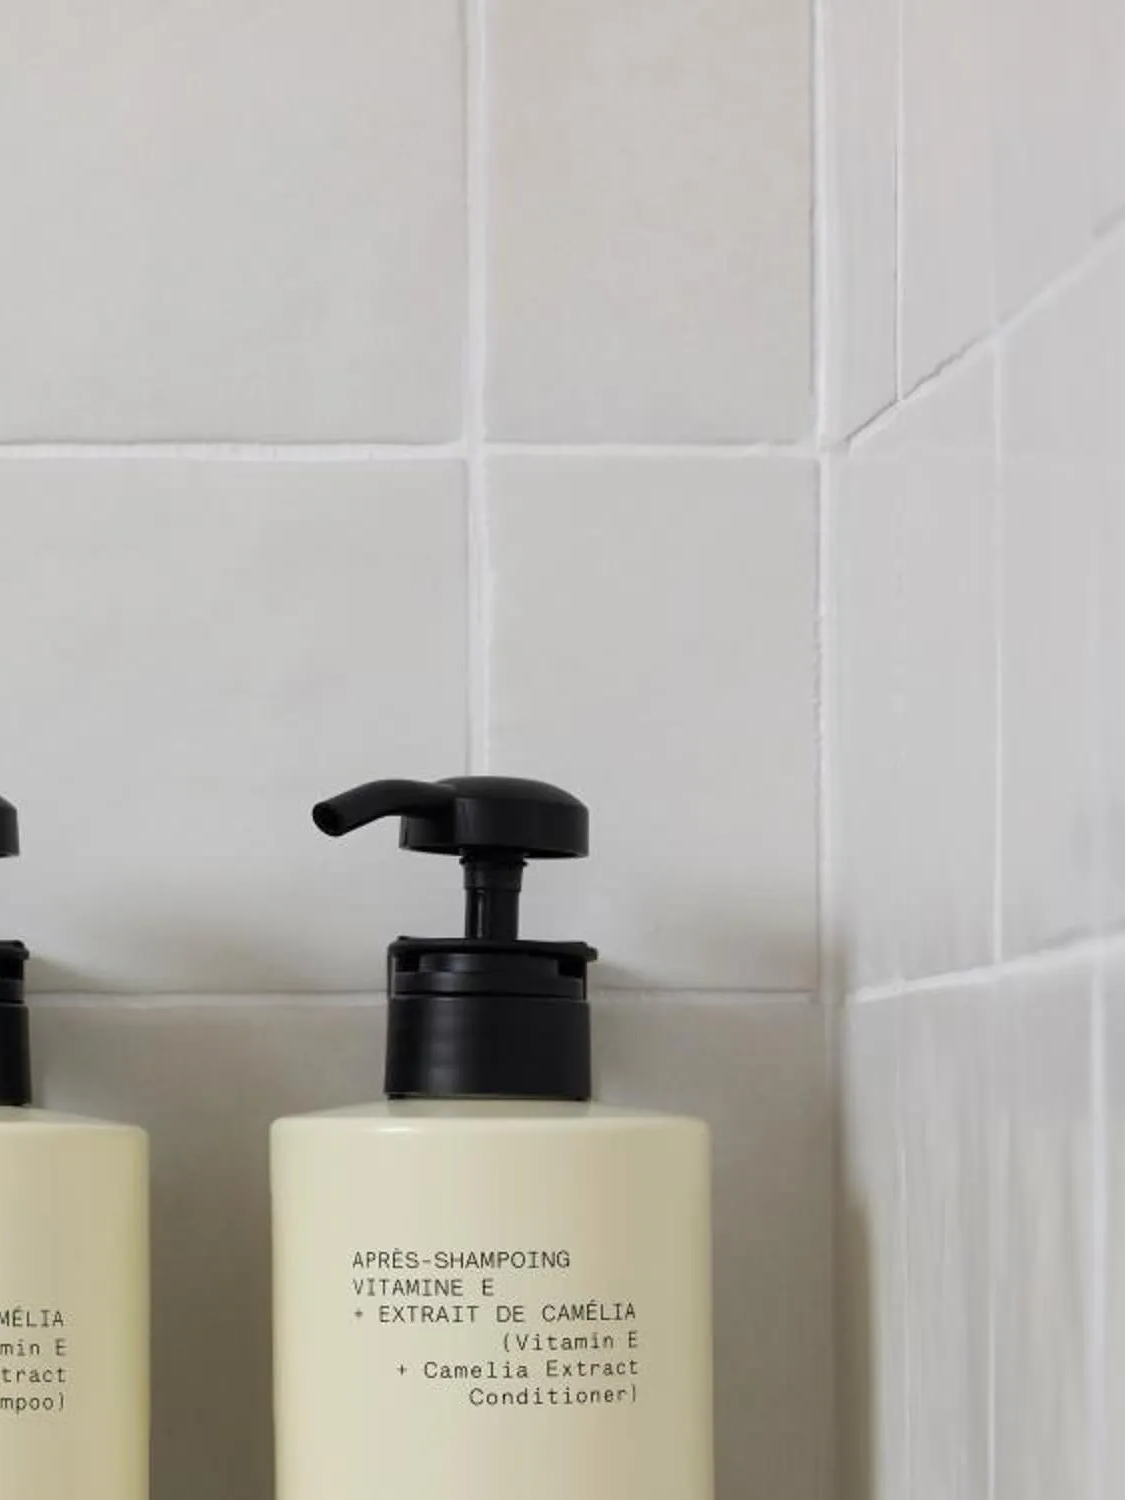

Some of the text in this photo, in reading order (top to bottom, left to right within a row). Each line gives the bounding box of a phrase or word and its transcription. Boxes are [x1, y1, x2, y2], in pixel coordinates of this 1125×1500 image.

[352, 1249, 571, 1269] APRÈS-SHAMPOING
[352, 1278, 495, 1298] VITAMINE E
[378, 1304, 480, 1324] EXTRAIT
[496, 1304, 526, 1323] DE
[541, 1300, 636, 1323] CAMÉLIA
[55, 1338, 68, 1357] E
[502, 1330, 638, 1353] (Vitamin E
[423, 1360, 530, 1380] Camelia
[546, 1359, 638, 1378] Extract
[468, 1386, 638, 1407] Conditioner)
